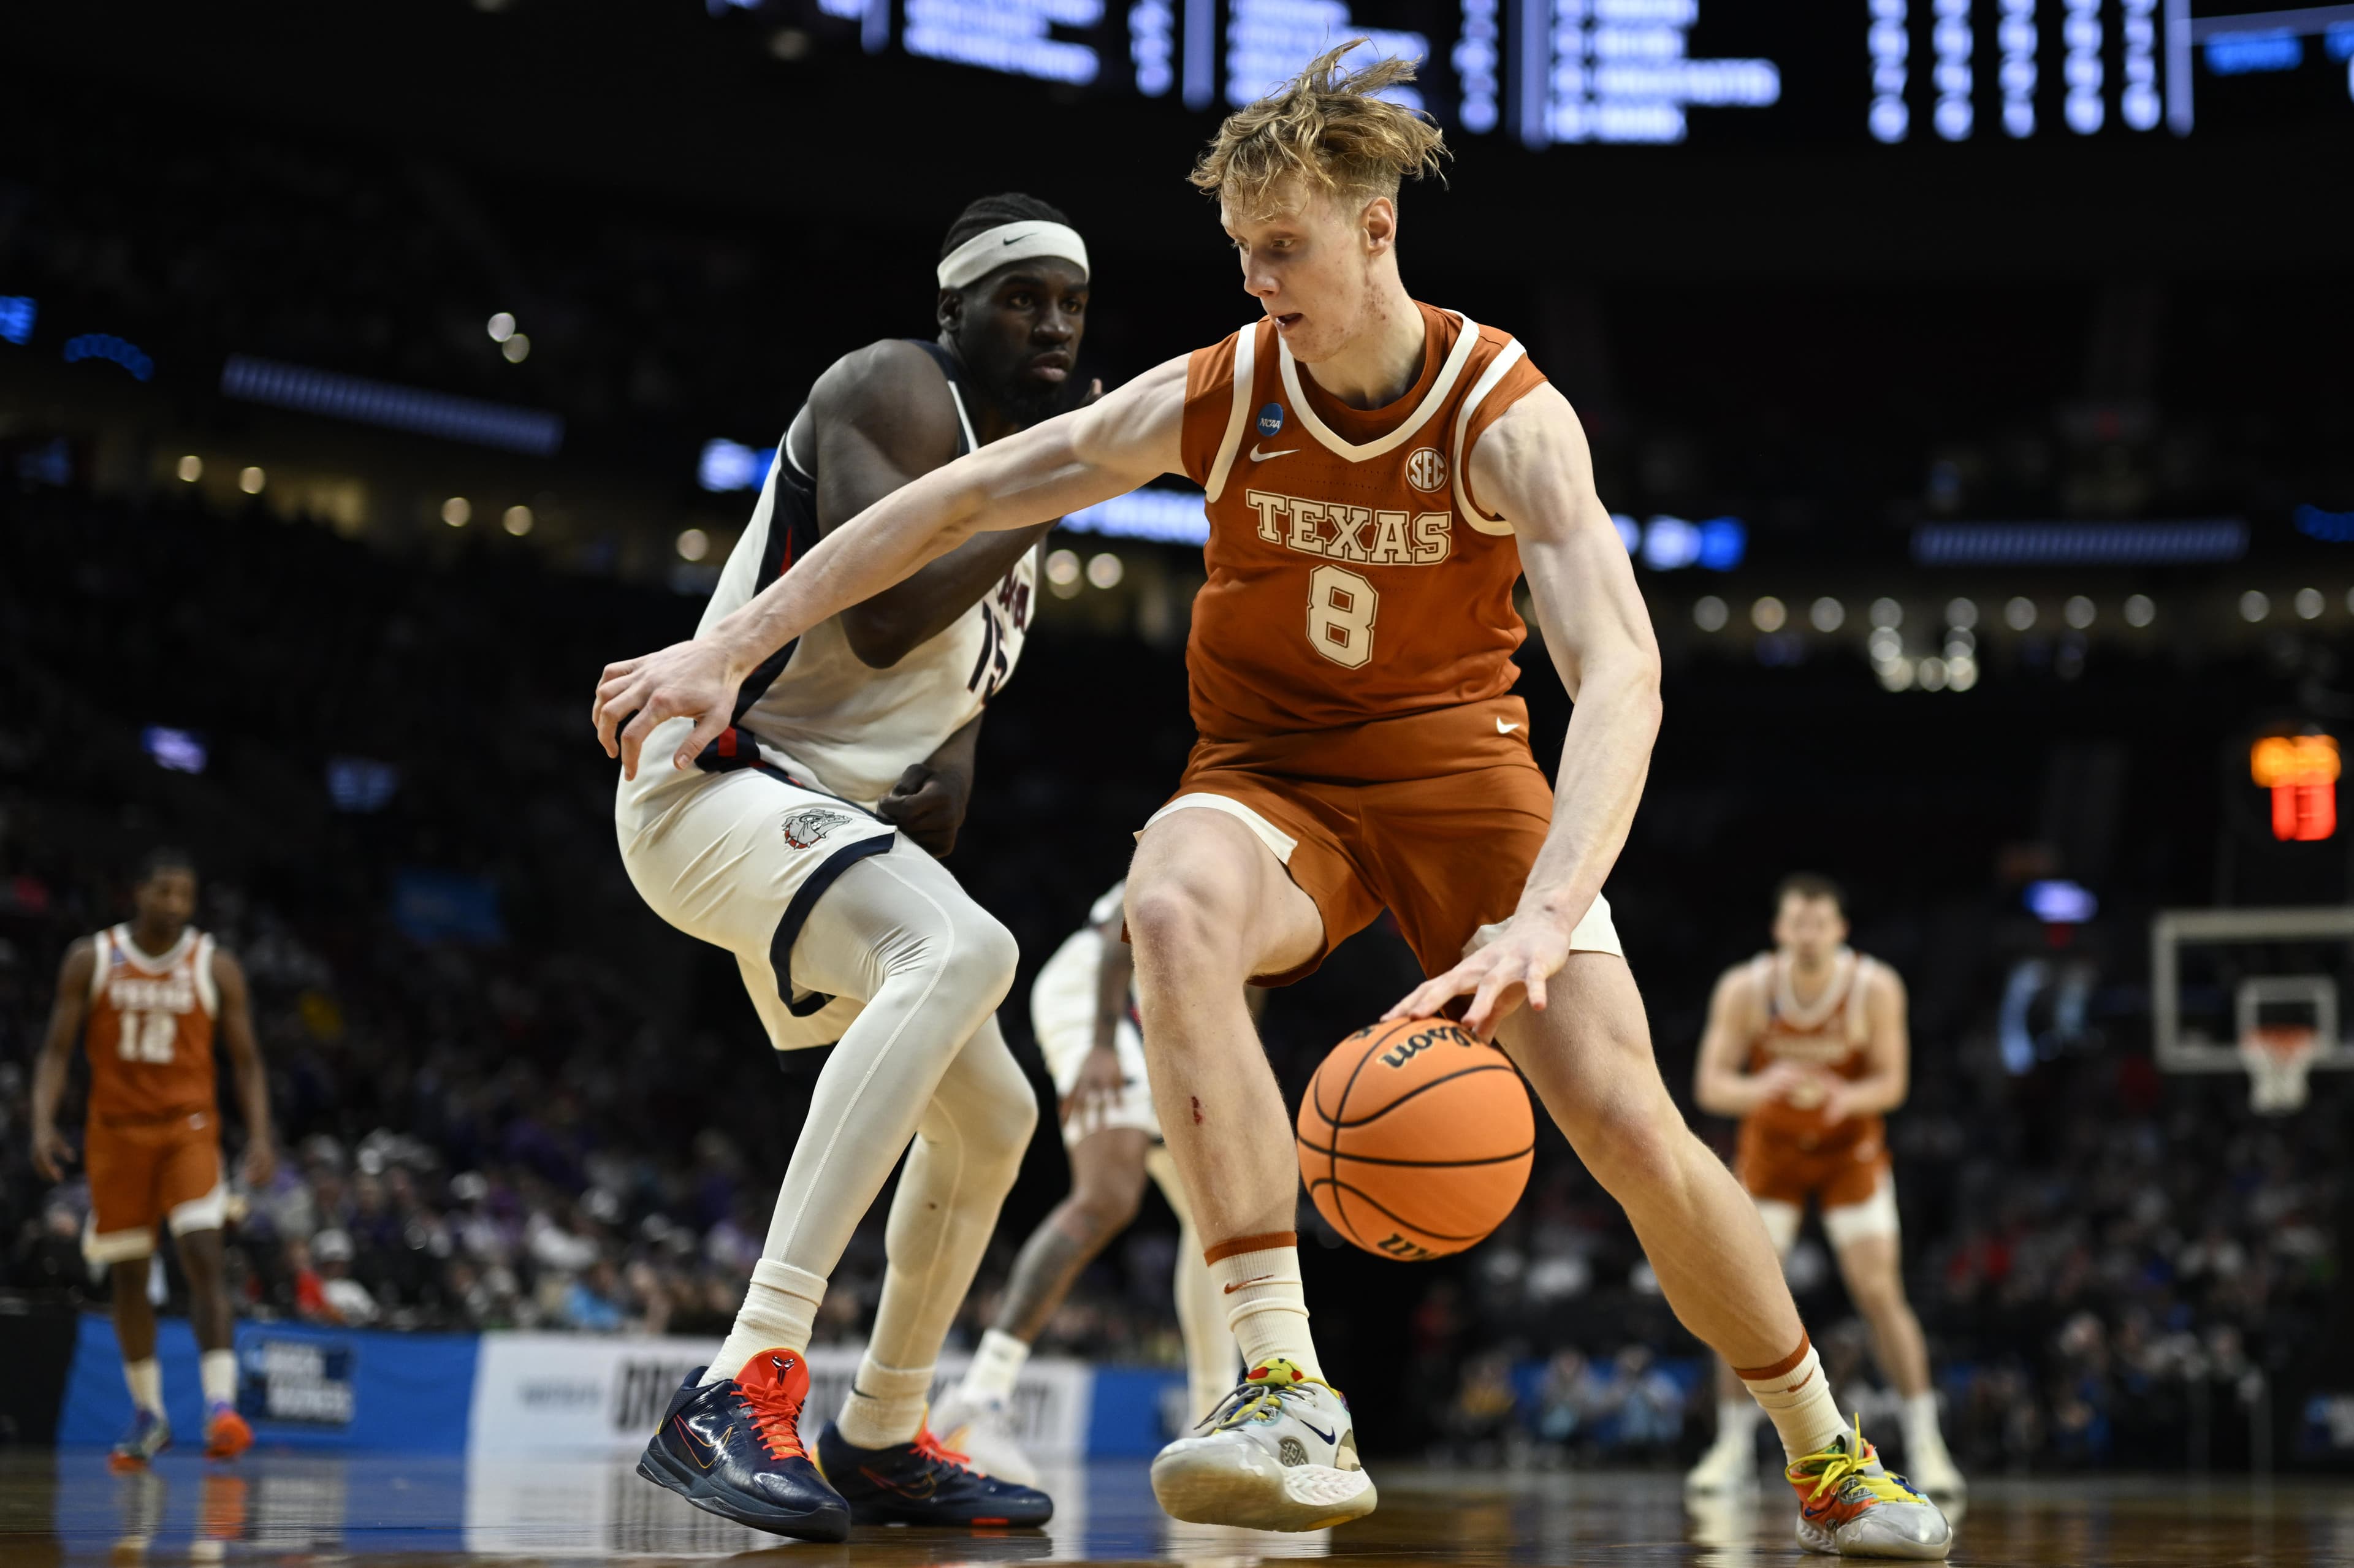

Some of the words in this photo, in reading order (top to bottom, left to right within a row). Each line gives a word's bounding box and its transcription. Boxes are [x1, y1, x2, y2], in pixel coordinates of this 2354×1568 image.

[1259, 417, 1281, 429] NCAA
[1410, 451, 1444, 489] SEC
[1246, 489, 1451, 566] TEXAS
[1307, 565, 1378, 669] 8
[1381, 1026, 1472, 1068] lson
